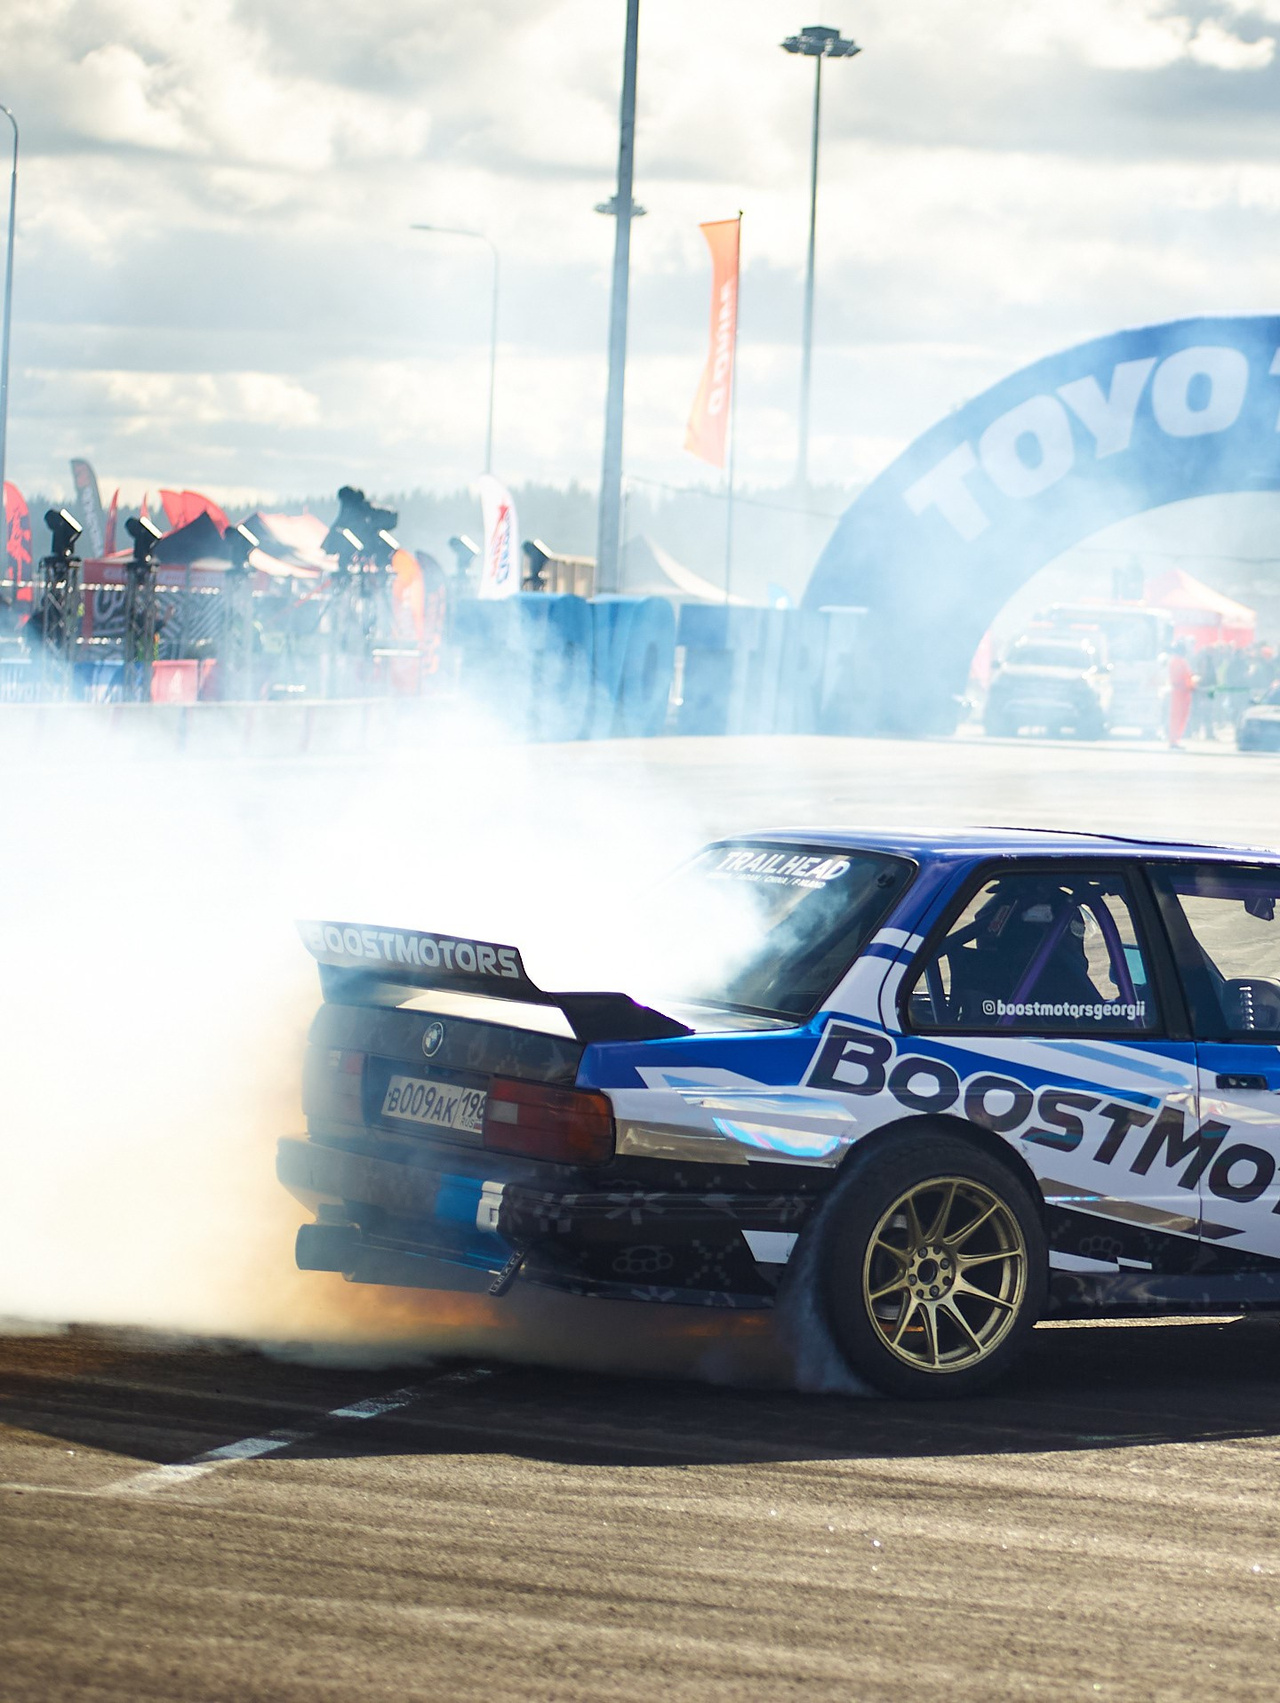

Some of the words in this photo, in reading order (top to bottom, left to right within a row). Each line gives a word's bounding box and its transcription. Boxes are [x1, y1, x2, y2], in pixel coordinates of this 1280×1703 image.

[903, 346, 1249, 543] TOYO
[716, 852, 851, 880] TRAILHEAD
[309, 924, 520, 979] BOOSTMOTORS
